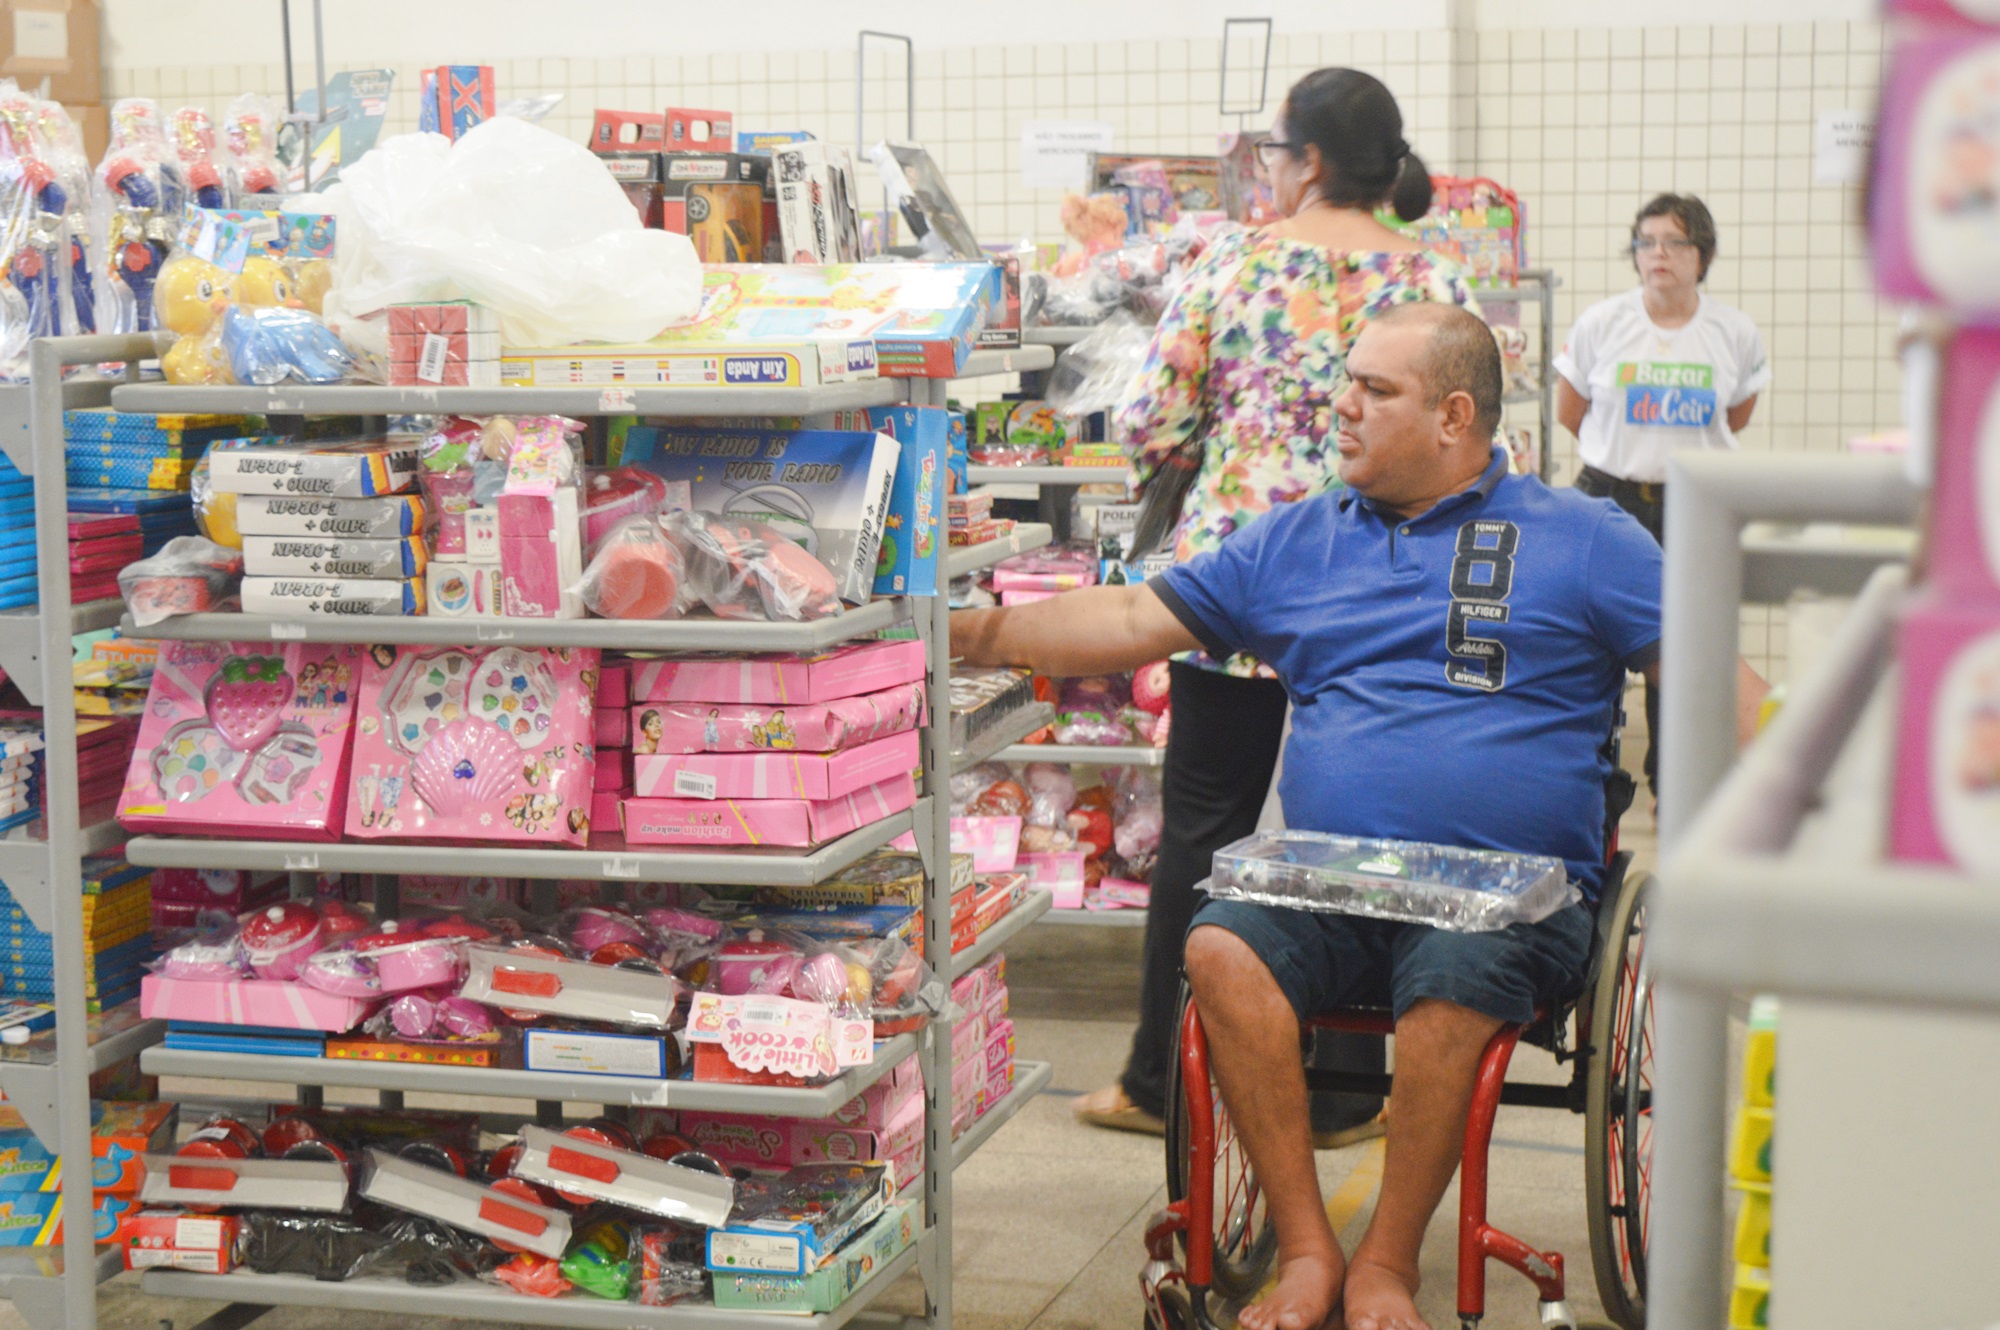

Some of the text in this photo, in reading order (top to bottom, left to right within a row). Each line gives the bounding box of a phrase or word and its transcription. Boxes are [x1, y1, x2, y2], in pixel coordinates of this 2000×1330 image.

[726, 360, 786, 380] Xin Anda
[700, 435, 760, 457] RADIO
[764, 437, 788, 458] IS
[237, 458, 304, 475] E-ORGAN
[723, 461, 843, 484] YOUR RADIO
[287, 478, 334, 493] RADIO
[266, 499, 339, 516] E-ORGAN
[320, 519, 371, 534] RADIO
[1474, 522, 1506, 533] TOMMY
[272, 542, 341, 559] E-ORGAN
[324, 560, 374, 575] RADIO
[270, 581, 342, 598] E-ORGAN
[324, 600, 373, 614] RADIO
[1461, 604, 1503, 618] HILFIGER
[1454, 672, 1494, 688] DIVISION
[763, 1048, 815, 1070] Little
